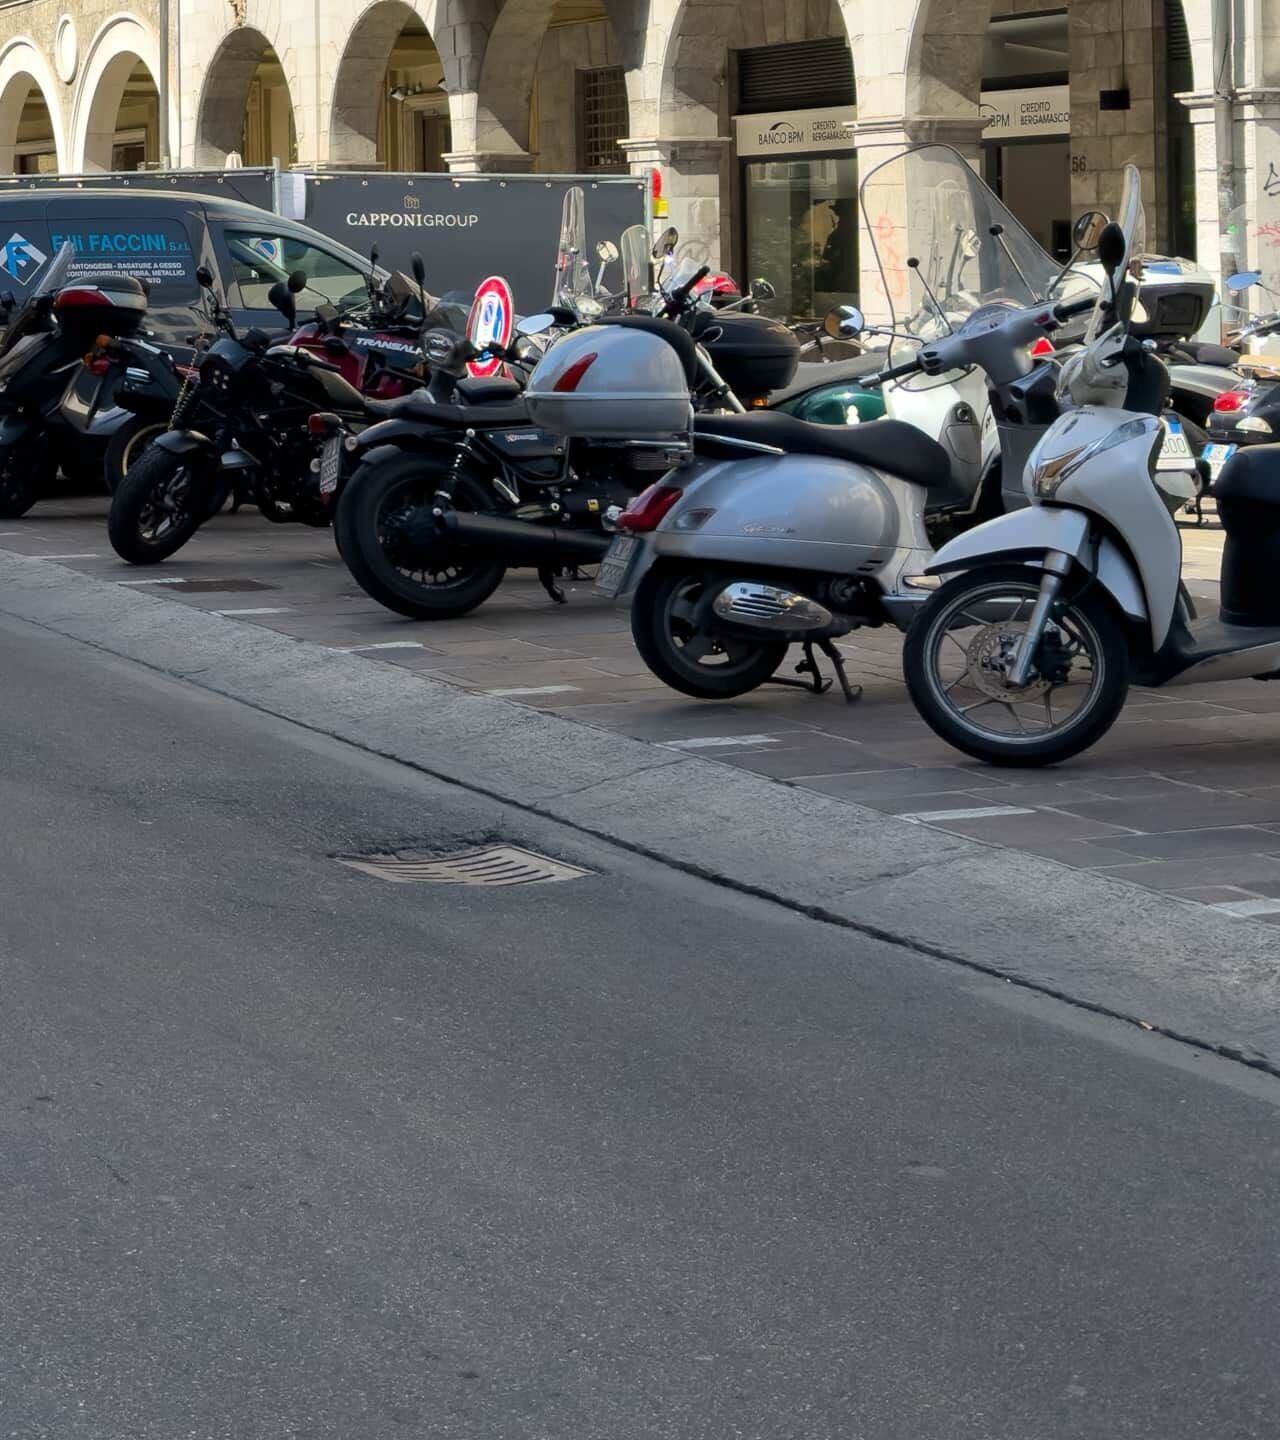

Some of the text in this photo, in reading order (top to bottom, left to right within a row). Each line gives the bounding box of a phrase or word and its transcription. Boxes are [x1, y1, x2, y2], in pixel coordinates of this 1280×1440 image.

[1020, 101, 1051, 113] CREDITO
[812, 120, 837, 131] CREDITO
[1020, 112, 1071, 126] BERGAMASCO
[758, 131, 787, 145] BANCO
[788, 131, 804, 143] BPM
[346, 213, 479, 227] CAPPONIGROUP
[89, 233, 167, 251] FACCINI
